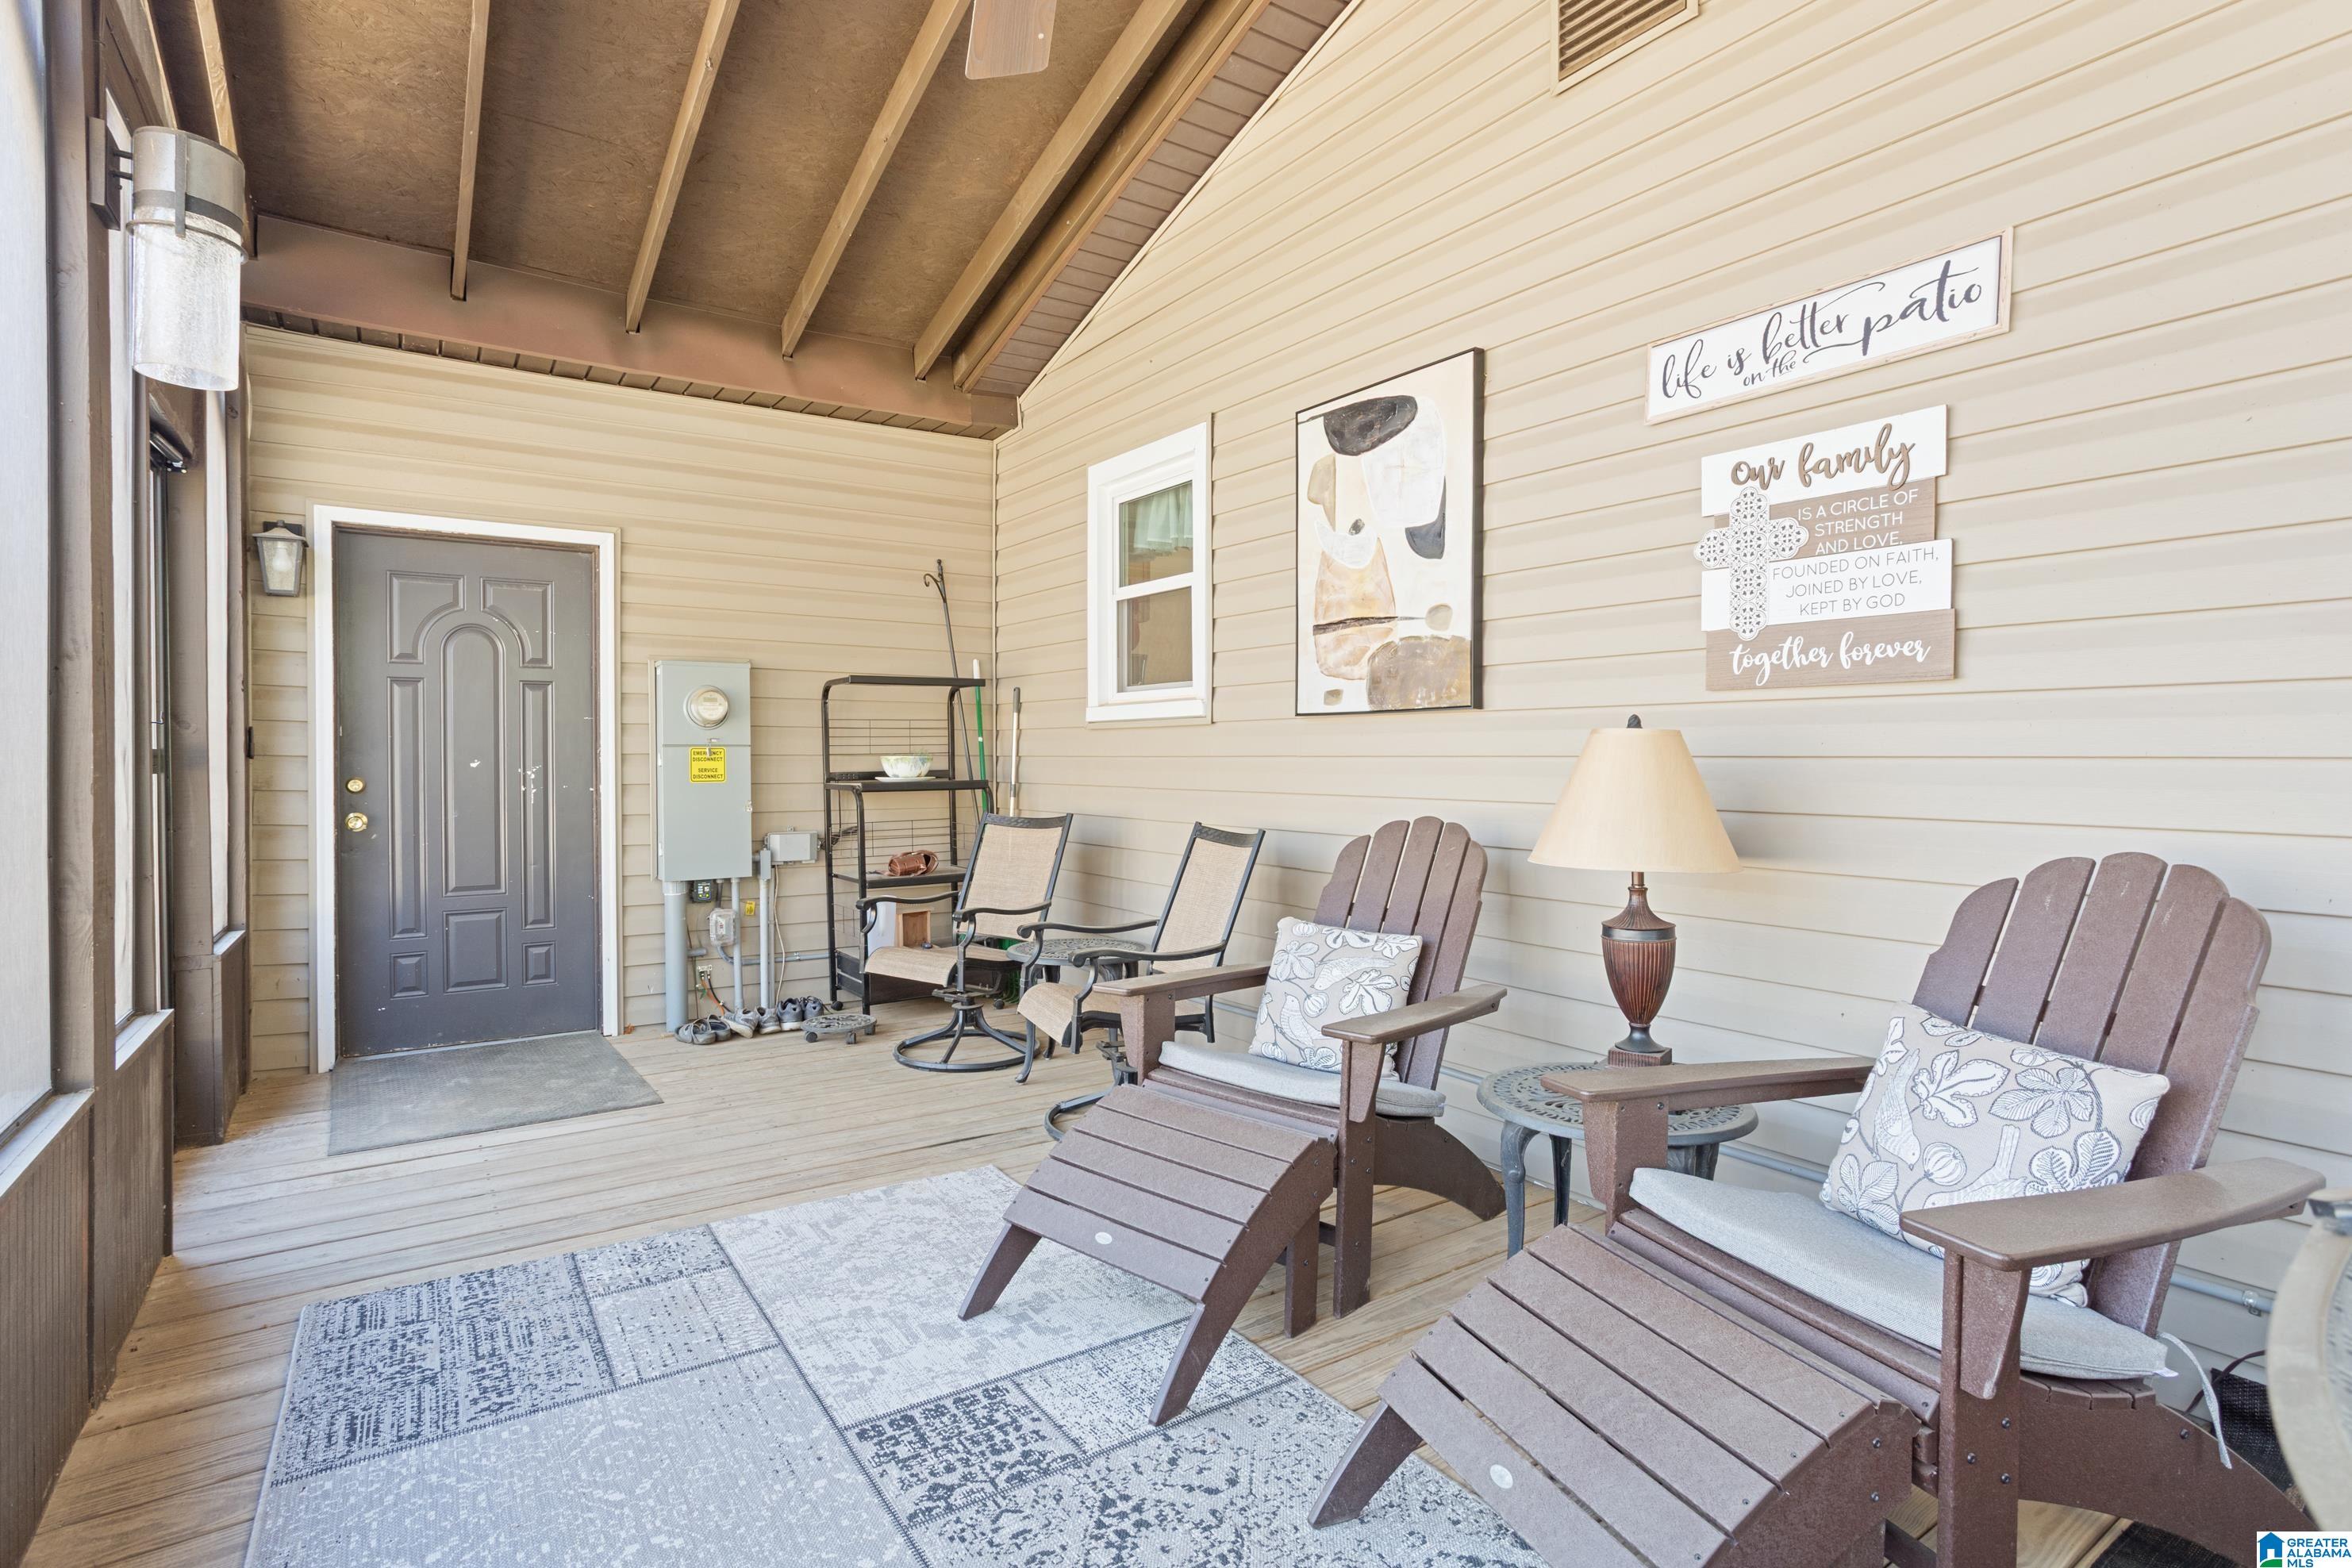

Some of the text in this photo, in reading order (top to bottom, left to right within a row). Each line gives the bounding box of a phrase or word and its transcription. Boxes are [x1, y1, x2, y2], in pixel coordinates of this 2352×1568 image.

[1743, 259, 1982, 386] on the patio
[1662, 282, 1885, 398] life is better
[1797, 423, 1916, 491] family
[1797, 488, 1919, 521] IS A CIRCLE OF
[1815, 511, 1903, 537] STRENGTH
[1815, 531, 1903, 555] AND LOVE.
[1773, 547, 1939, 580] FOUNDED ON FAITH,
[1785, 570, 1923, 598] JOINED BY LOVE,
[1800, 594, 1905, 616] KEPT BY GOD
[1729, 631, 1931, 686] together forever
